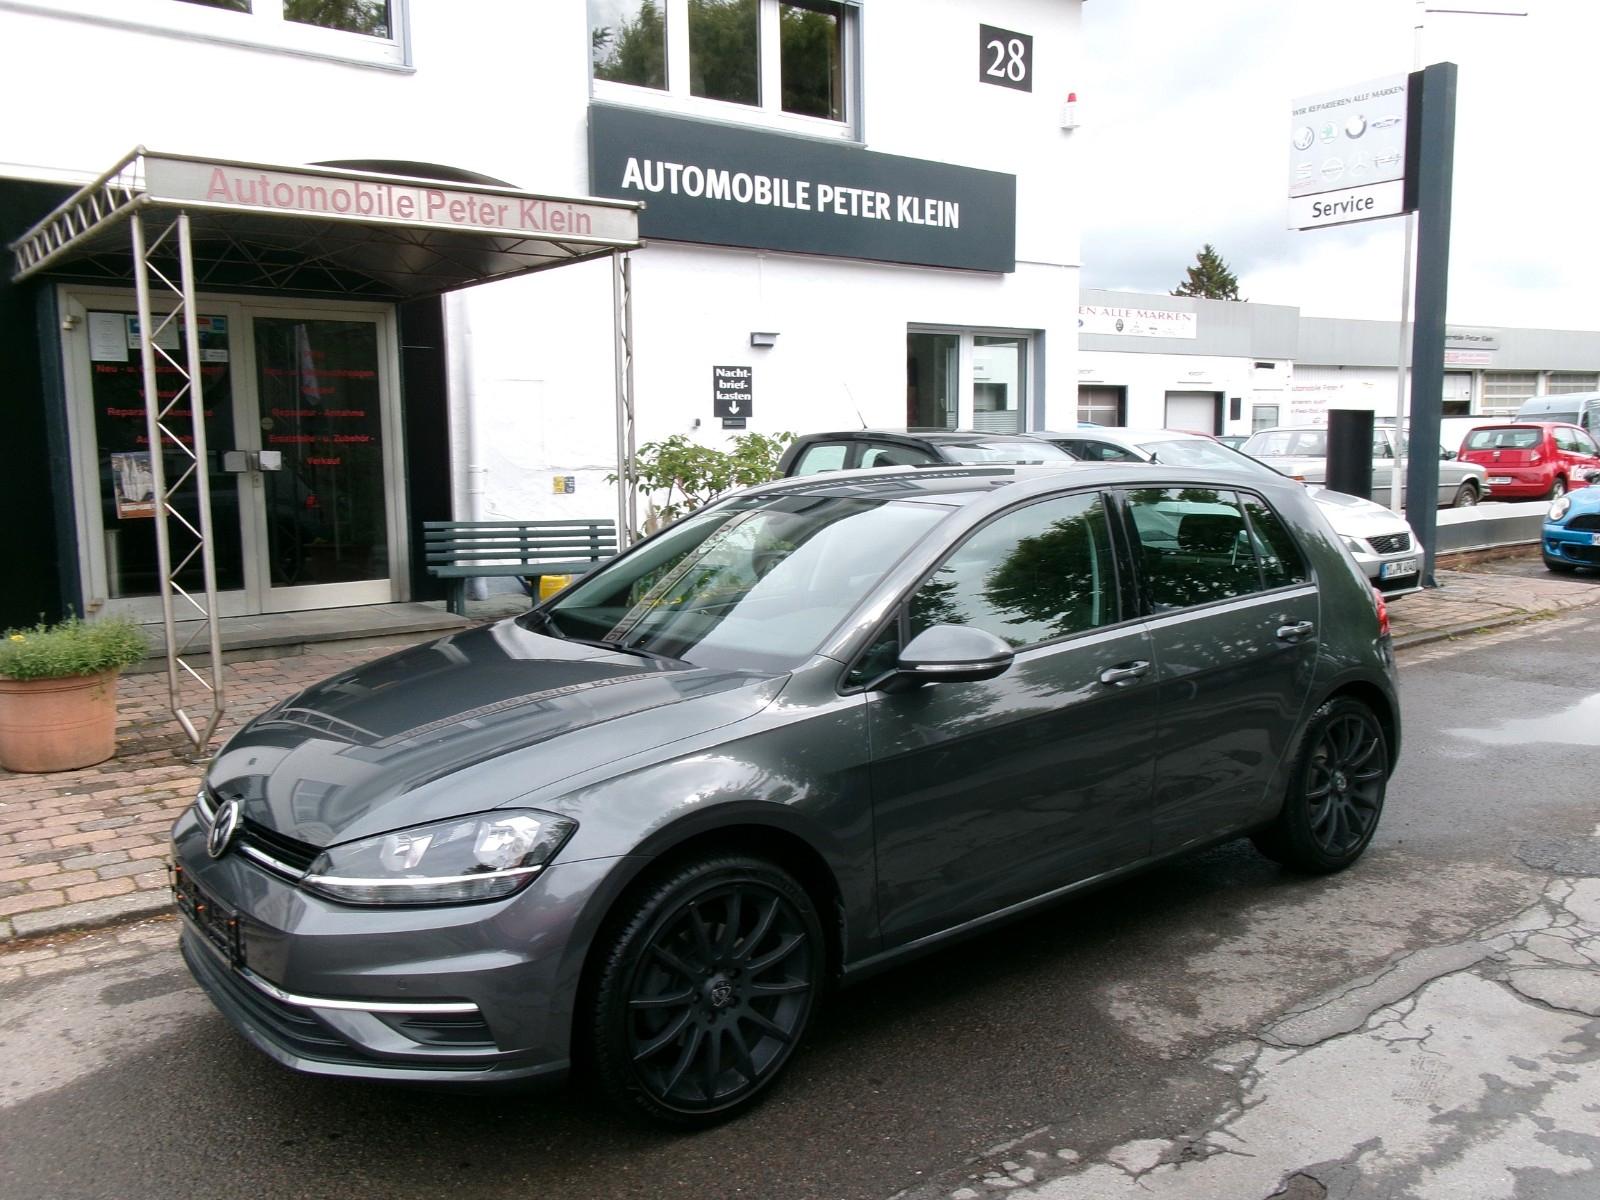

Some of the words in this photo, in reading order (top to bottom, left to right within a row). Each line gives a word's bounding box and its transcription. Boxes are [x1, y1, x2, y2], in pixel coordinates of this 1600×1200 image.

[986, 38, 1026, 82] 28
[1353, 92, 1370, 103] ALLE
[1371, 85, 1405, 99] MARKEN
[206, 167, 415, 219] Automobile
[426, 189, 509, 227] Peter
[519, 200, 592, 235] Klein
[621, 157, 811, 211] AUTOMOBILE
[817, 183, 892, 222] PETER
[897, 194, 960, 230] KLEIN
[1312, 195, 1375, 218] Service
[1101, 308, 1133, 318] ALLE
[1137, 311, 1192, 321] MARKEN
[716, 368, 752, 378] Nacht-
[719, 379, 749, 389] brief-
[716, 390, 751, 400] kasten
